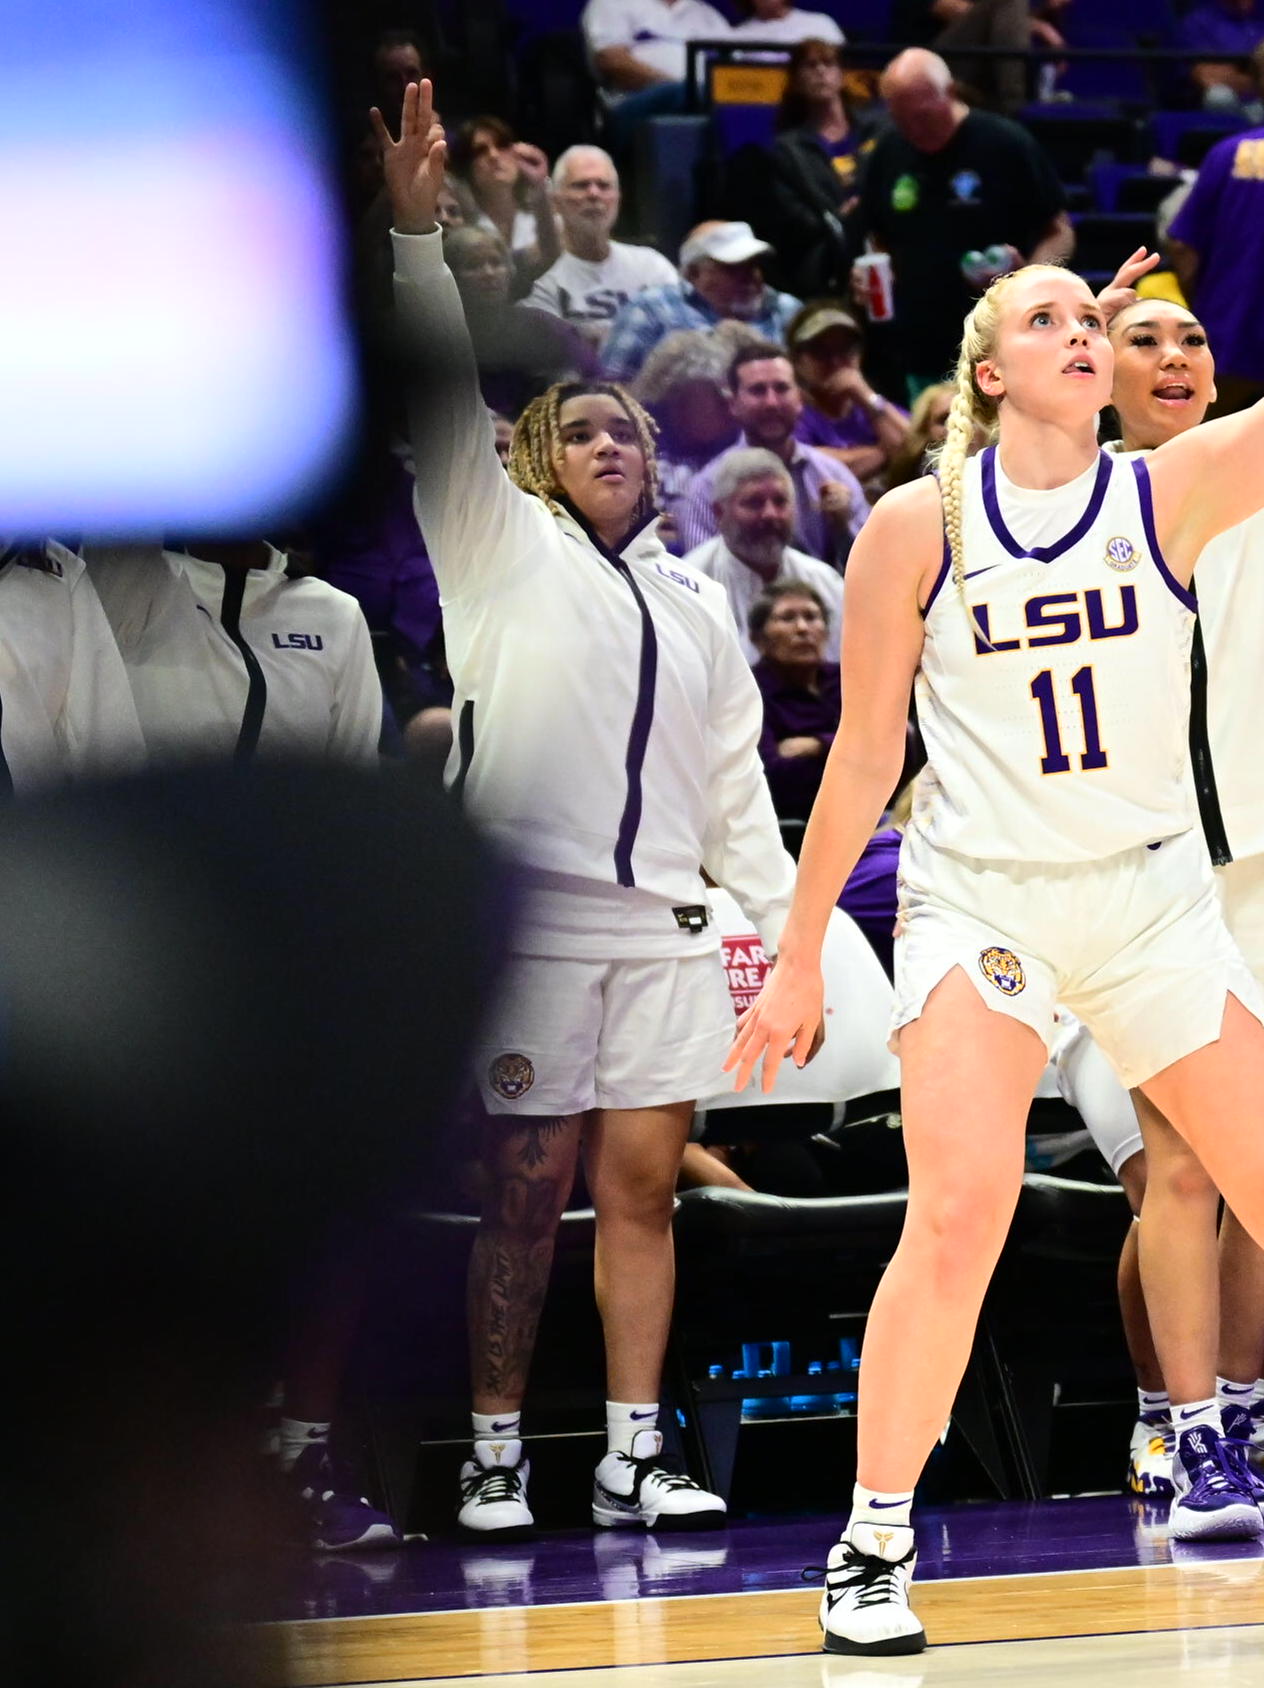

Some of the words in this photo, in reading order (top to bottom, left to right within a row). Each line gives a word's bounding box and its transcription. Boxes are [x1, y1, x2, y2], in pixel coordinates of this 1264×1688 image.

[1108, 538, 1133, 562] SEC
[655, 561, 701, 594] LSU
[970, 583, 1140, 656] LSU
[271, 632, 324, 651] LSU
[1029, 663, 1110, 775] 11
[720, 944, 770, 968] FAR
